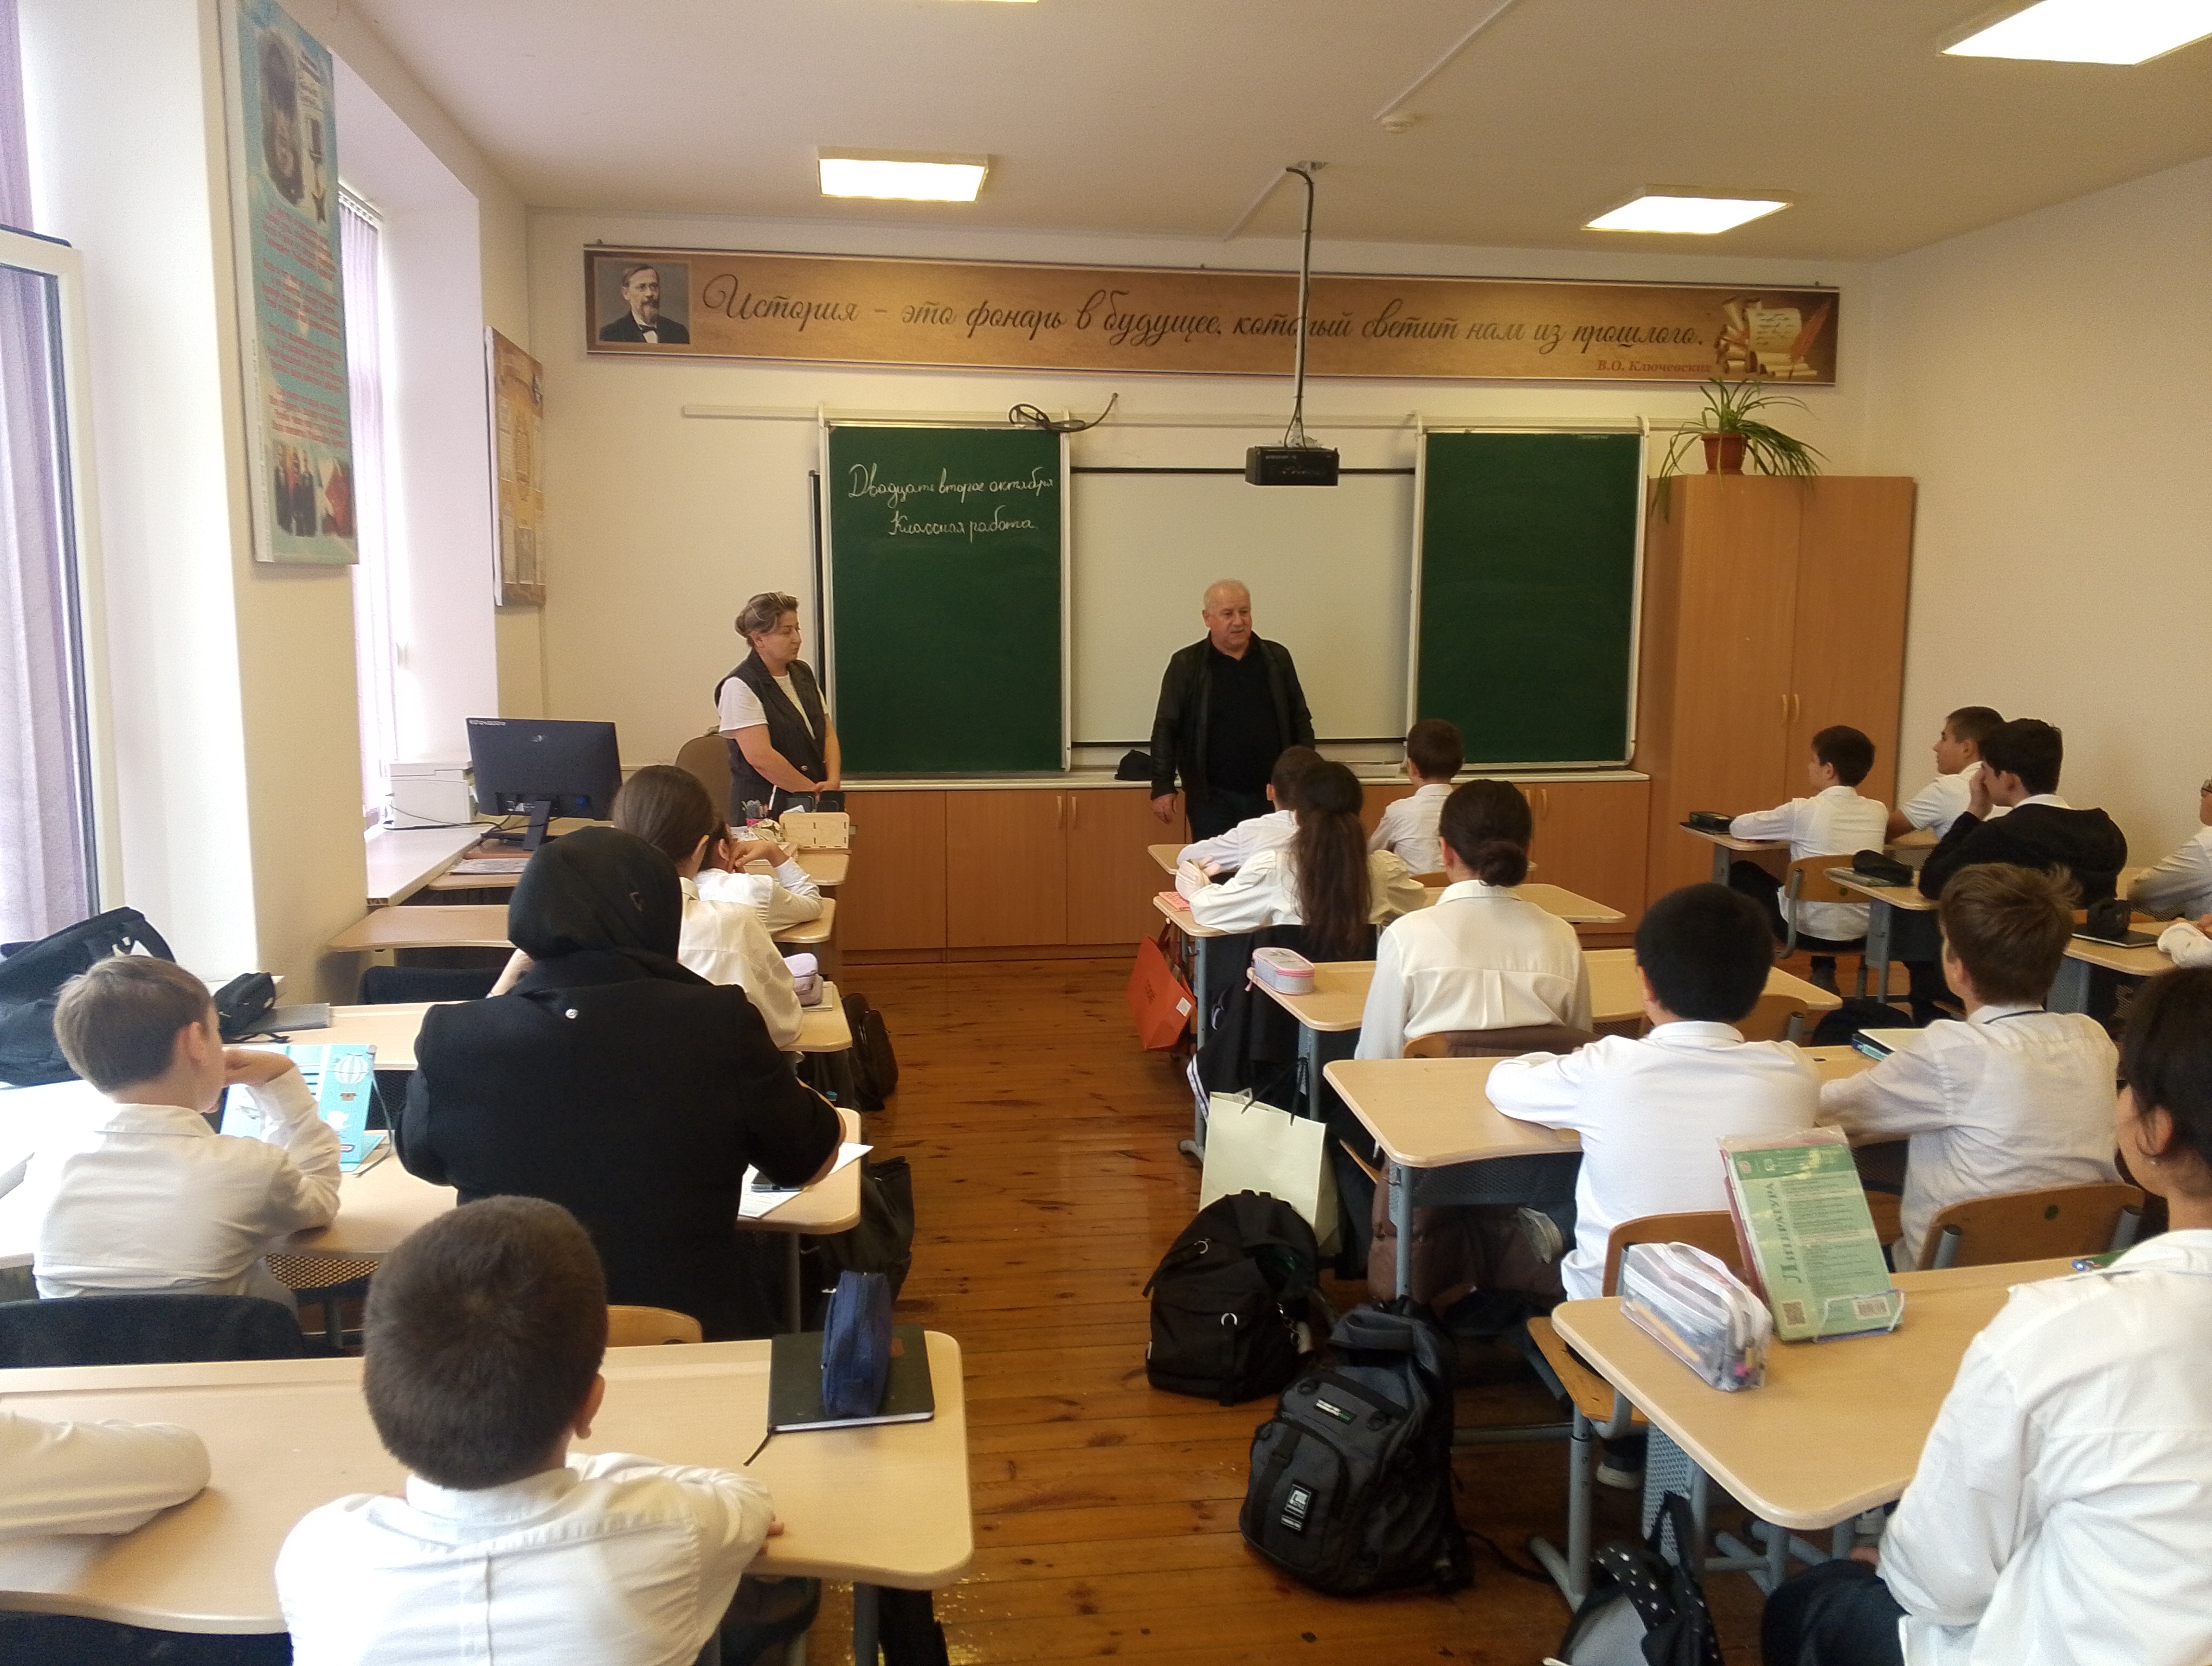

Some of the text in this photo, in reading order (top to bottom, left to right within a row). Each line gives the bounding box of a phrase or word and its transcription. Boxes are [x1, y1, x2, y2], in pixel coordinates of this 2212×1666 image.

[703, 273, 860, 332] История
[902, 301, 957, 324] это
[966, 300, 1066, 341] фонарь
[1076, 290, 1106, 330] в
[1361, 298, 1461, 340] светит
[1465, 321, 1526, 342] нам
[1533, 324, 1565, 355] из
[1572, 324, 1703, 354] прошлого.
[848, 462, 1053, 509] Двадцать второе октября
[888, 504, 1038, 543] Классная работа
